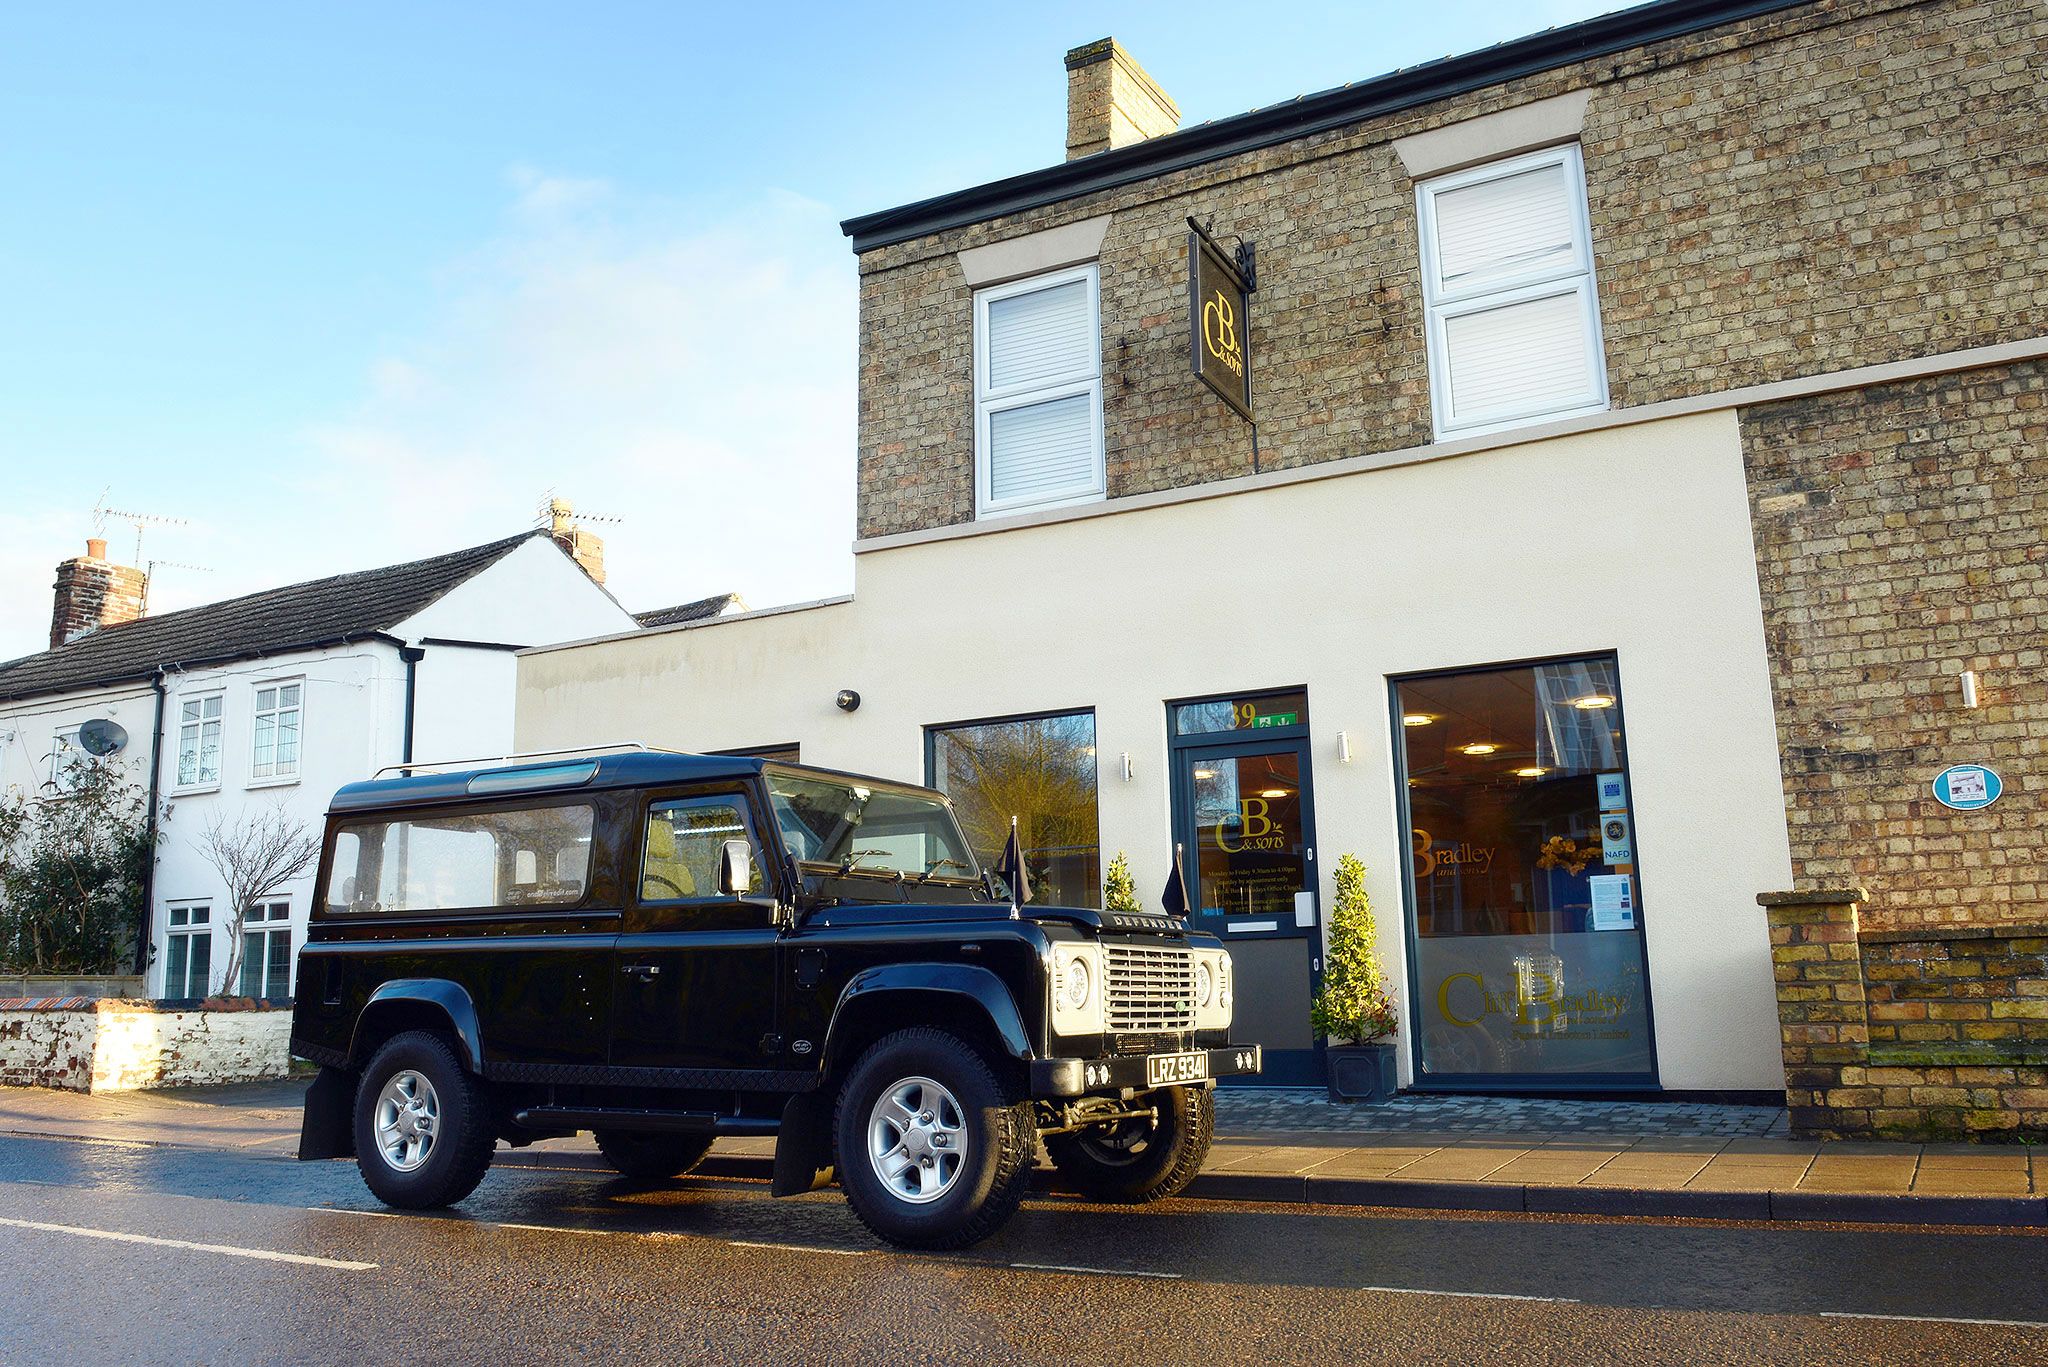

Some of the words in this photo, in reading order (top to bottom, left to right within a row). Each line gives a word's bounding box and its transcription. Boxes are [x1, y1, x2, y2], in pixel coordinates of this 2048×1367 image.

[1242, 838, 1253, 851] &
[1253, 835, 1285, 850] sons
[1412, 829, 1496, 878] Bradley
[1605, 850, 1631, 859] NAFD
[1235, 868, 1251, 877] Friday
[1277, 865, 1297, 874] 4.00pm
[1113, 915, 1184, 931] DEFENDER
[1151, 1057, 1177, 1084] LRZ
[1178, 1054, 1206, 1080] 9341
